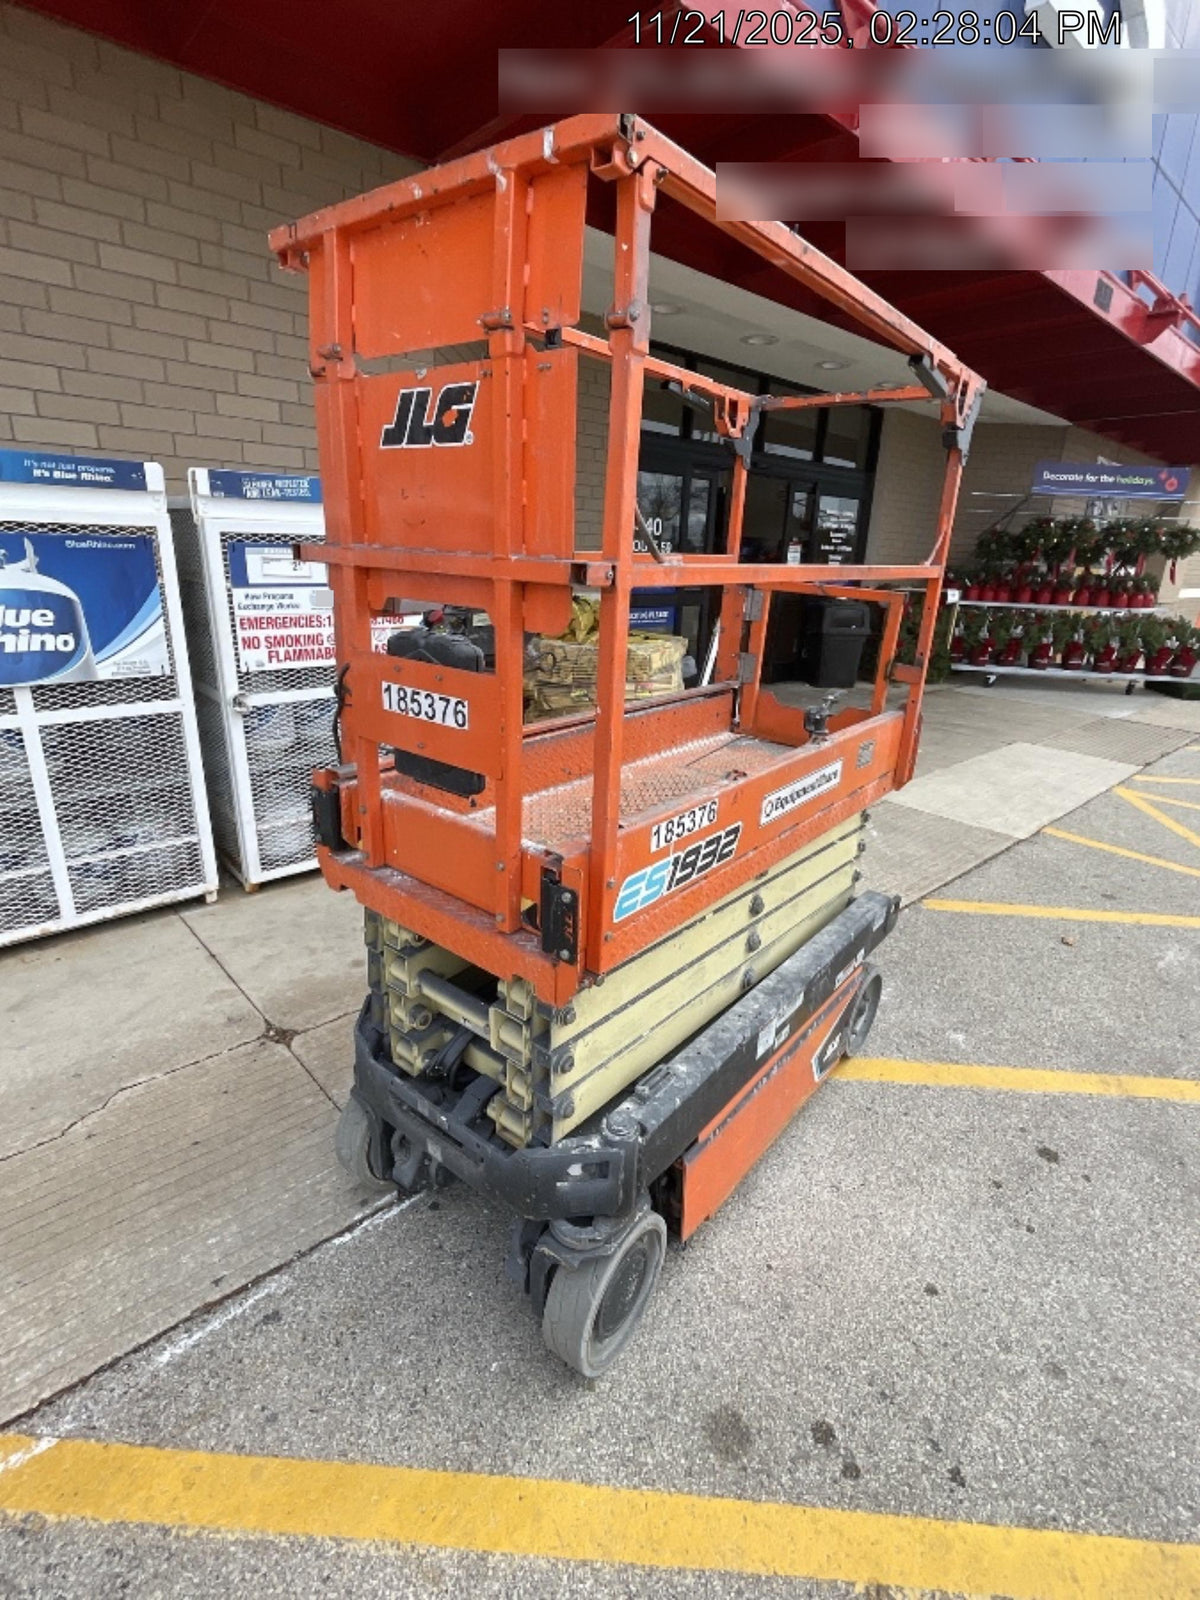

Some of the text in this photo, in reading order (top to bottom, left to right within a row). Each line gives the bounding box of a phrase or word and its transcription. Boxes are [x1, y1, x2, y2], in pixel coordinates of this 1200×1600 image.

[380, 380, 481, 447] JLG
[33, 468, 51, 478] It's
[53, 470, 78, 479] Blue
[1043, 470, 1083, 482] Decorate
[1086, 472, 1098, 483] for
[1100, 474, 1117, 484] the
[0, 604, 56, 628] lue
[0, 628, 76, 653] hino
[241, 633, 324, 650] NO SMOKING
[383, 683, 467, 728] 185376
[653, 800, 718, 849] 185376
[613, 821, 743, 924] ES1932
